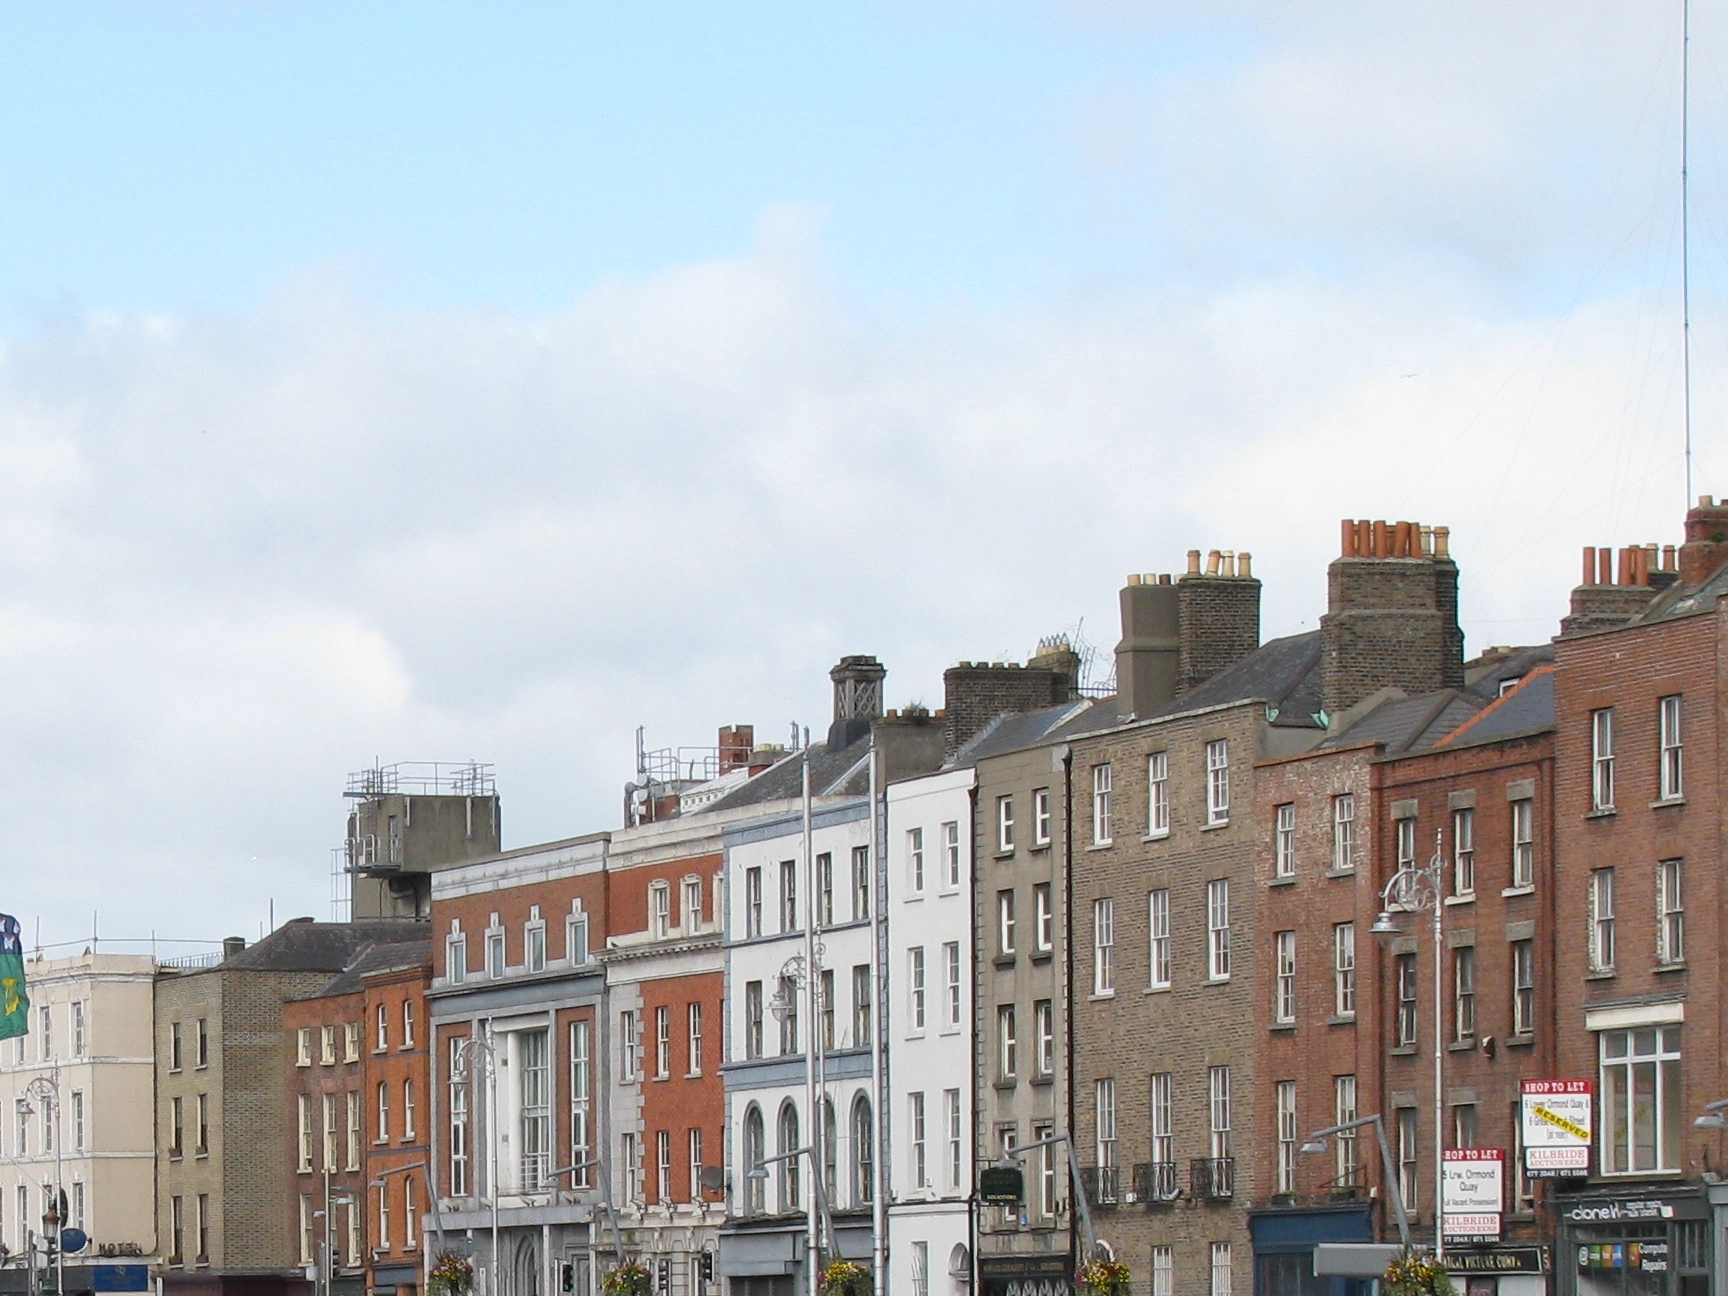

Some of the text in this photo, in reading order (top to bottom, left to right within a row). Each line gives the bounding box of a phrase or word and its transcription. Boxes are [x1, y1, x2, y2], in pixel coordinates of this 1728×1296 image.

[1525, 1082, 1584, 1092] SHOP TO LET
[1535, 1107, 1589, 1139] RESERVED
[1443, 1150, 1498, 1160] HOP TO LET
[1529, 1150, 1585, 1159] KILBRIDE
[1529, 1159, 1585, 1167] AUCTIONEERS
[1465, 1169, 1495, 1179] Ormond
[1459, 1181, 1478, 1192] Quay
[1443, 1216, 1497, 1225] KILBRIDE
